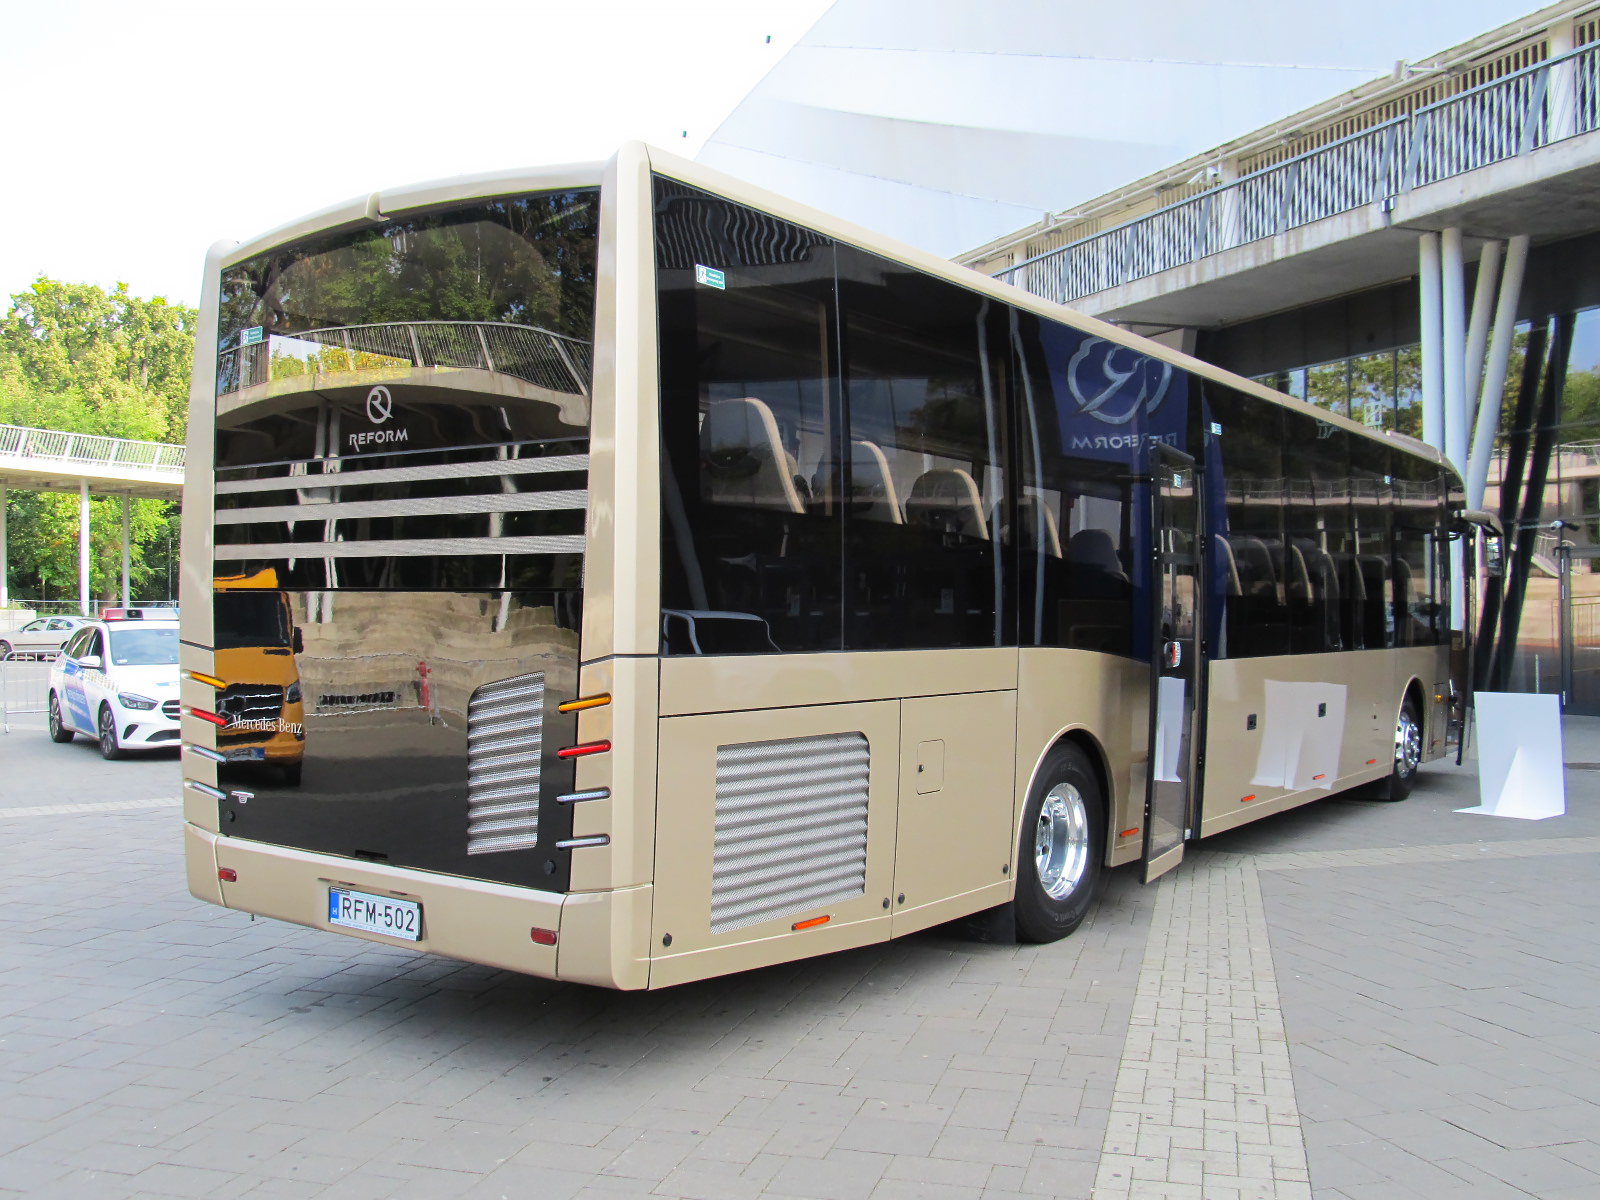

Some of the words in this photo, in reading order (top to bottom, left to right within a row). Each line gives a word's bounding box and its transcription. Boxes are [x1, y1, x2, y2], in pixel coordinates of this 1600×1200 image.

[349, 428, 408, 452] REFORM
[232, 714, 303, 734] Mercedes-Benz
[342, 897, 415, 933] RFM-502
